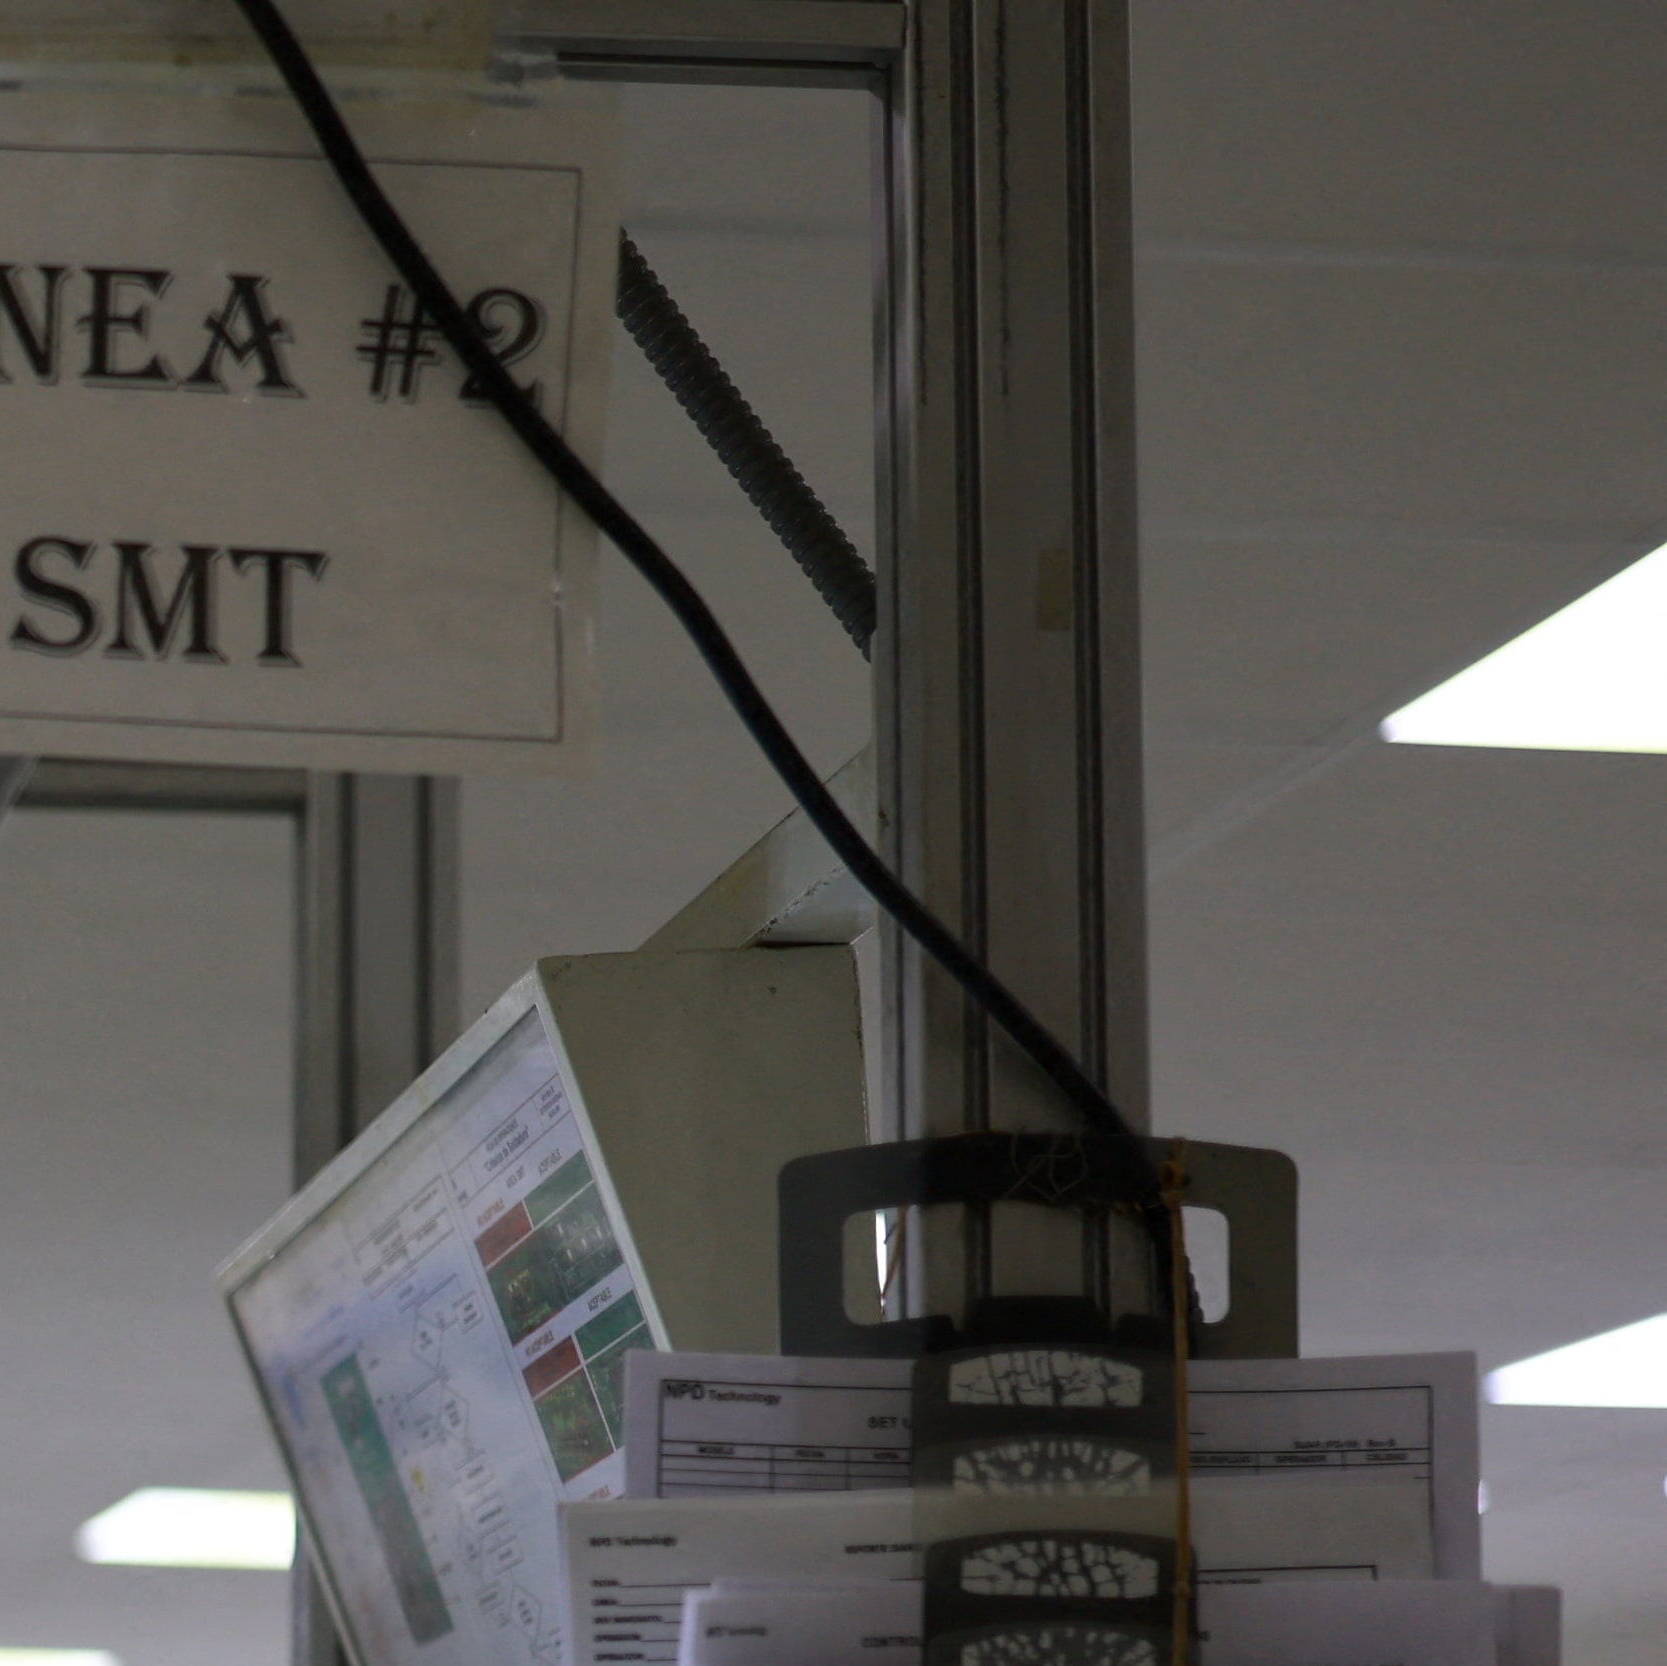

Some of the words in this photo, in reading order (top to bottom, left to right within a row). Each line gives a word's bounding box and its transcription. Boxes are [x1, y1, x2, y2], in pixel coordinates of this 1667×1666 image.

[356, 283, 546, 409] #2
[10, 533, 330, 668] SMT
[666, 1383, 706, 1400] NPD
[708, 1389, 782, 1405] Technology
